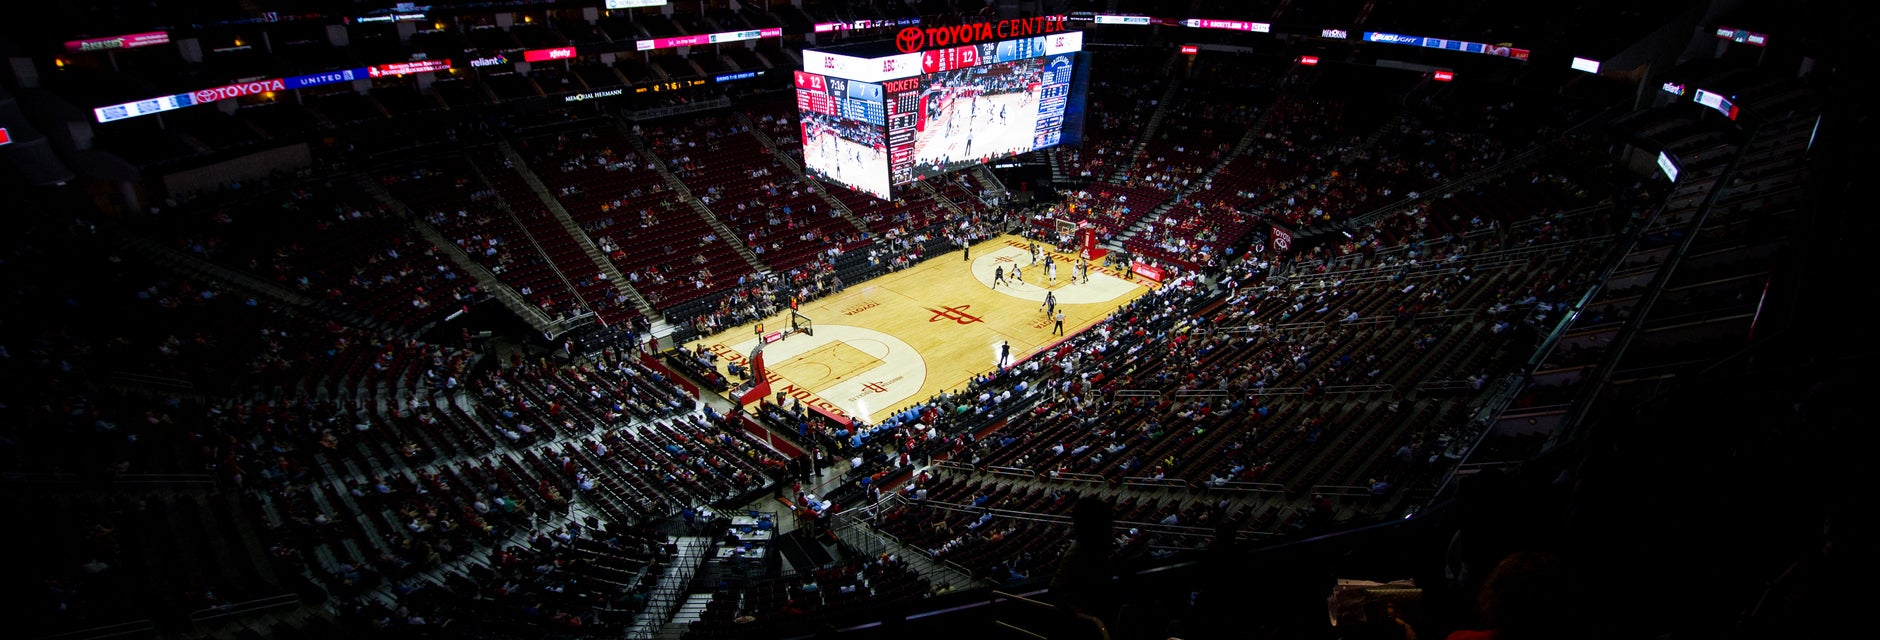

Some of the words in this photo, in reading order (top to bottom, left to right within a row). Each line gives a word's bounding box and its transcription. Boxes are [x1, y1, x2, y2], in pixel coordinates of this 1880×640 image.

[926, 22, 993, 47] TOYOTA
[997, 14, 1066, 38] CENTER
[983, 43, 994, 51] 7:16
[1007, 46, 1013, 56] 7
[470, 57, 499, 67] reliant
[963, 51, 973, 63] 12
[300, 74, 341, 85] UNITED
[810, 77, 822, 89] 12
[216, 80, 284, 99] TOYOTA
[830, 80, 845, 91] 7:16
[859, 85, 866, 96] 7
[1273, 227, 1291, 244] TOYOTA
